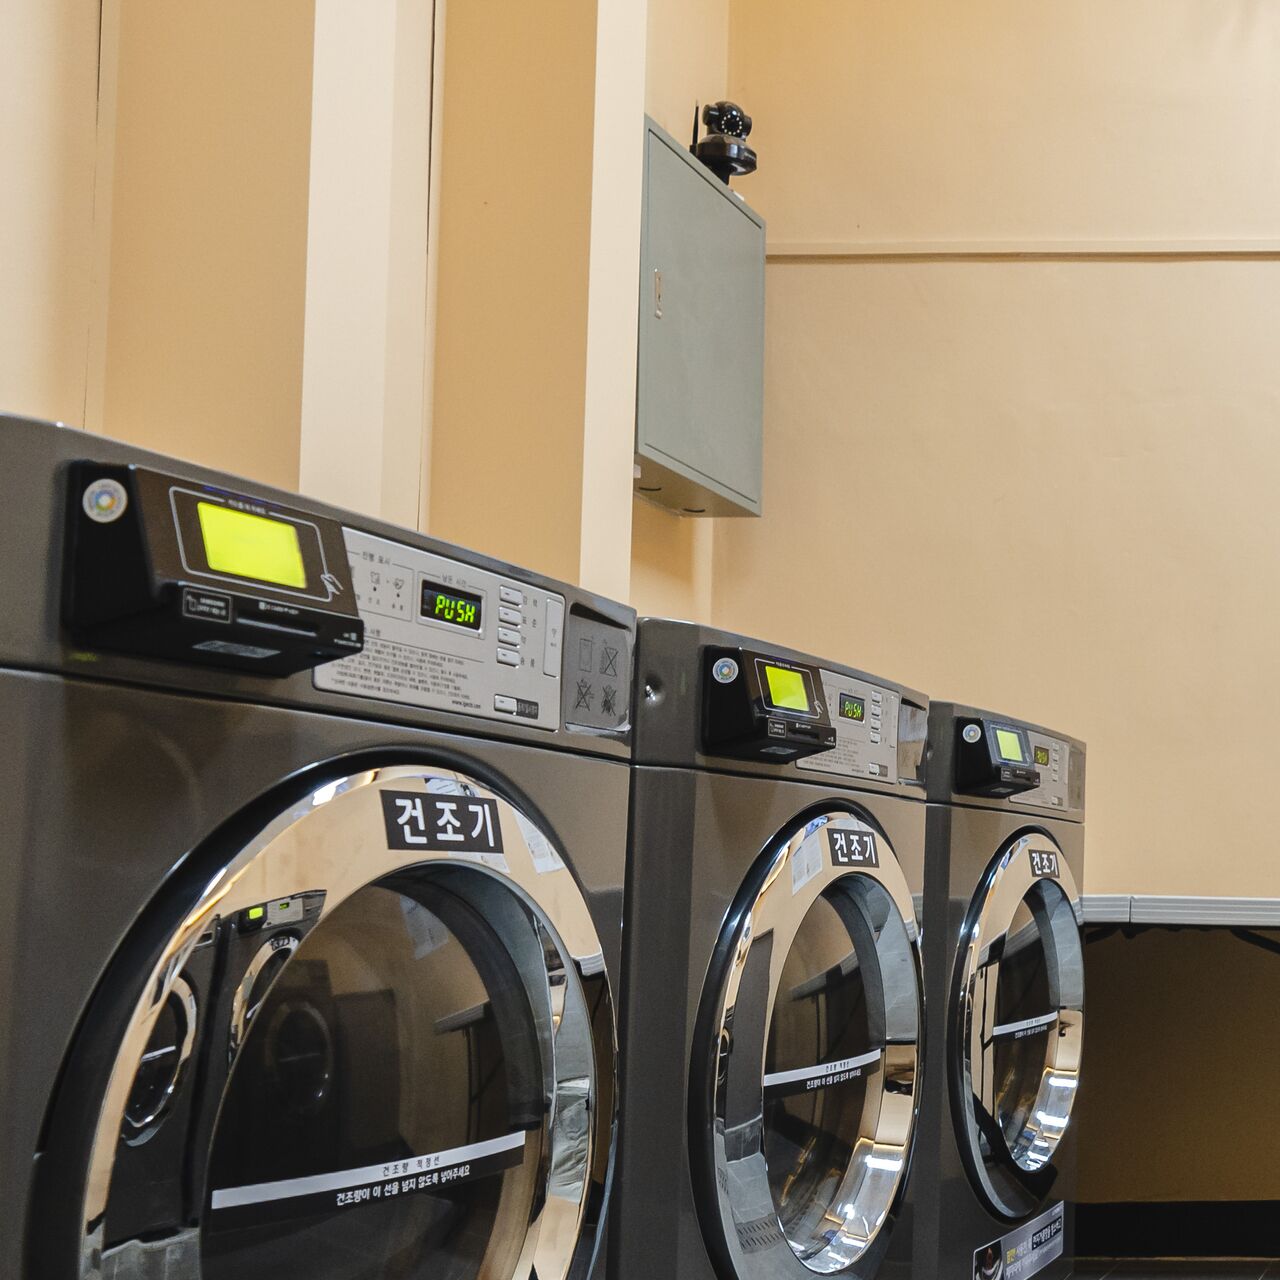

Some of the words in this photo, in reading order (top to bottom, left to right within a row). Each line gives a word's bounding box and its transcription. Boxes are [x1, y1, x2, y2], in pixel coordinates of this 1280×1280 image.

[434, 594, 475, 623] PUSH
[395, 798, 494, 847] 건조기
[833, 832, 876, 864] 건조기
[1031, 852, 1058, 876] 건조기
[383, 1162, 409, 1177] 건조량
[336, 1188, 370, 1206] 건조량이
[372, 1185, 381, 1198] 이
[383, 1182, 400, 1197] 선을
[401, 1178, 416, 1193] 넘지
[418, 1173, 439, 1189] 않도록
[440, 1164, 470, 1183] 넣어주세요
